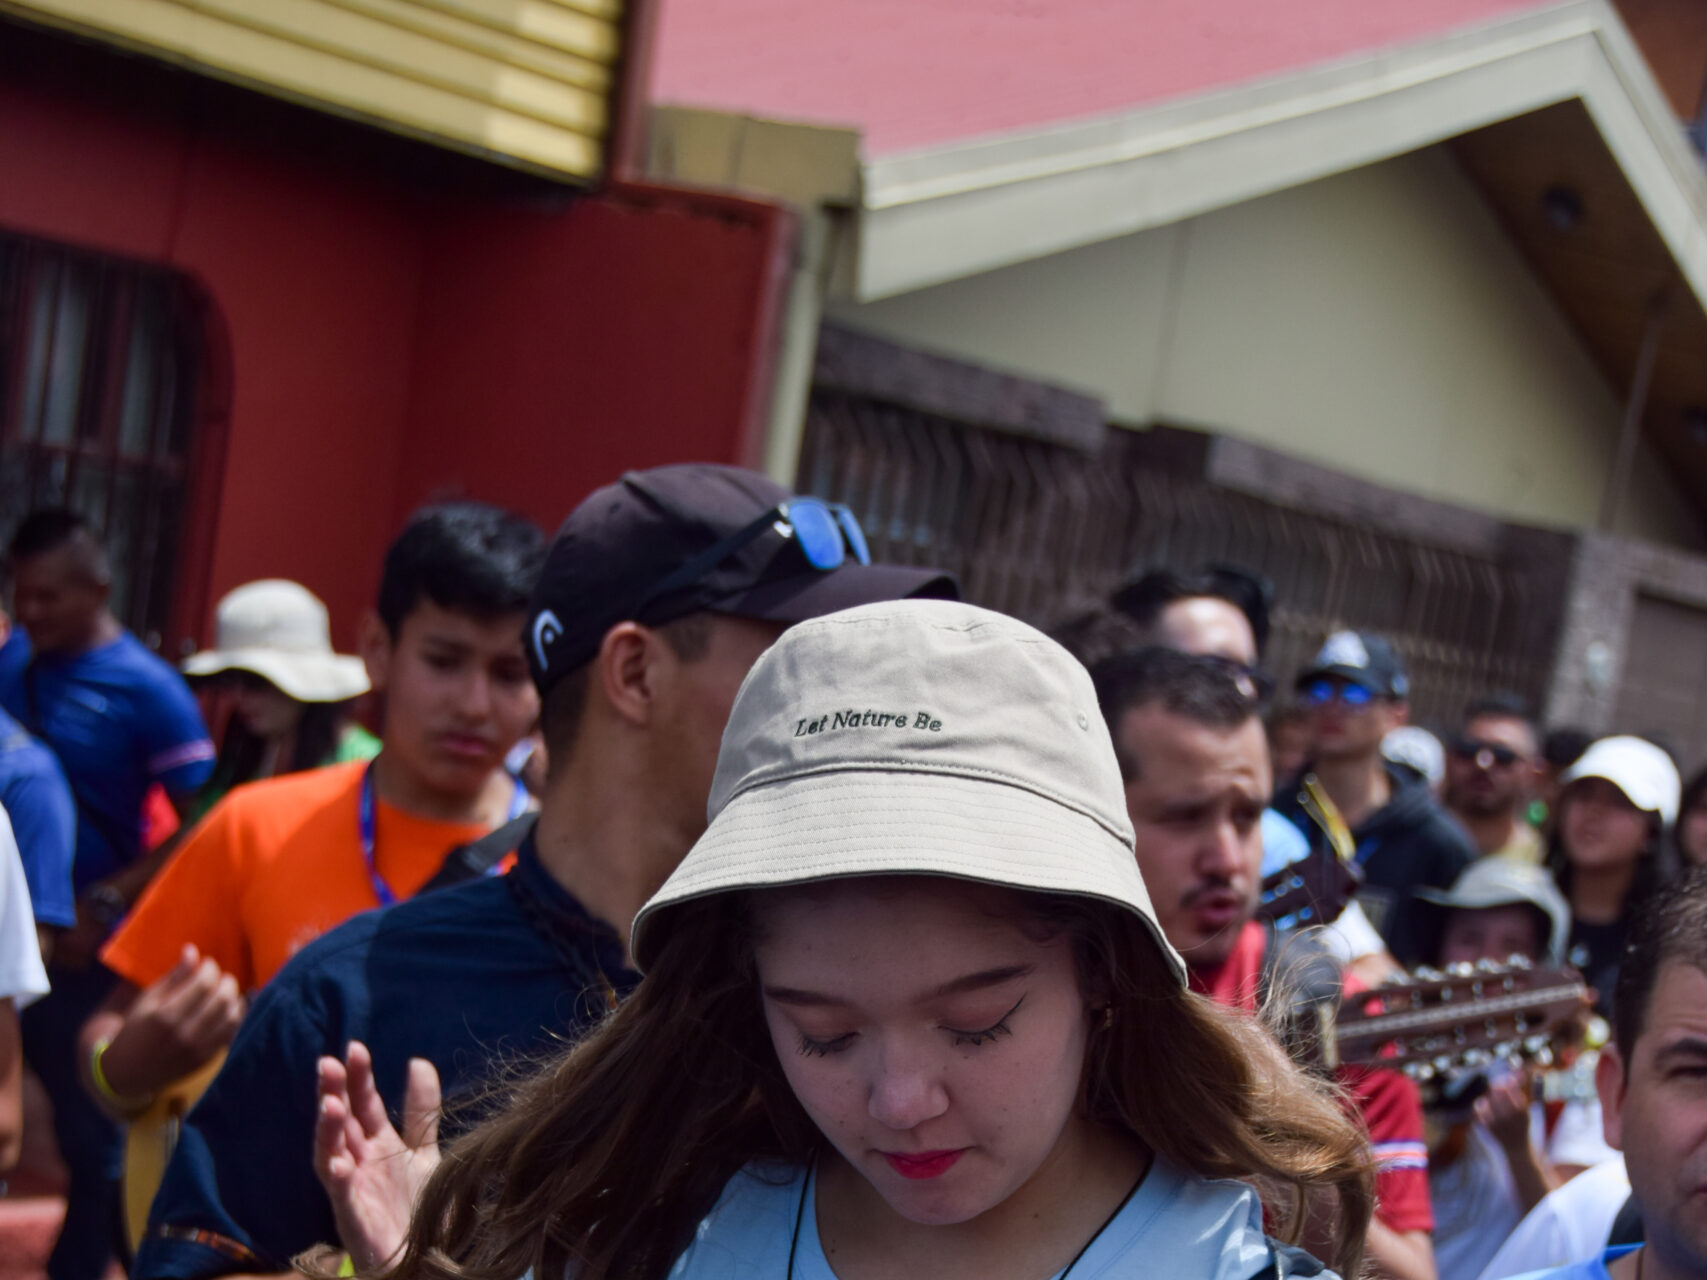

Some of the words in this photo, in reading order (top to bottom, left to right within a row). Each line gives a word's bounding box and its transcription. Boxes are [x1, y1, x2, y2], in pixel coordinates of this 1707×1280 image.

[794, 714, 828, 737] Let
[831, 708, 909, 730] Nature
[912, 711, 943, 732] Be
